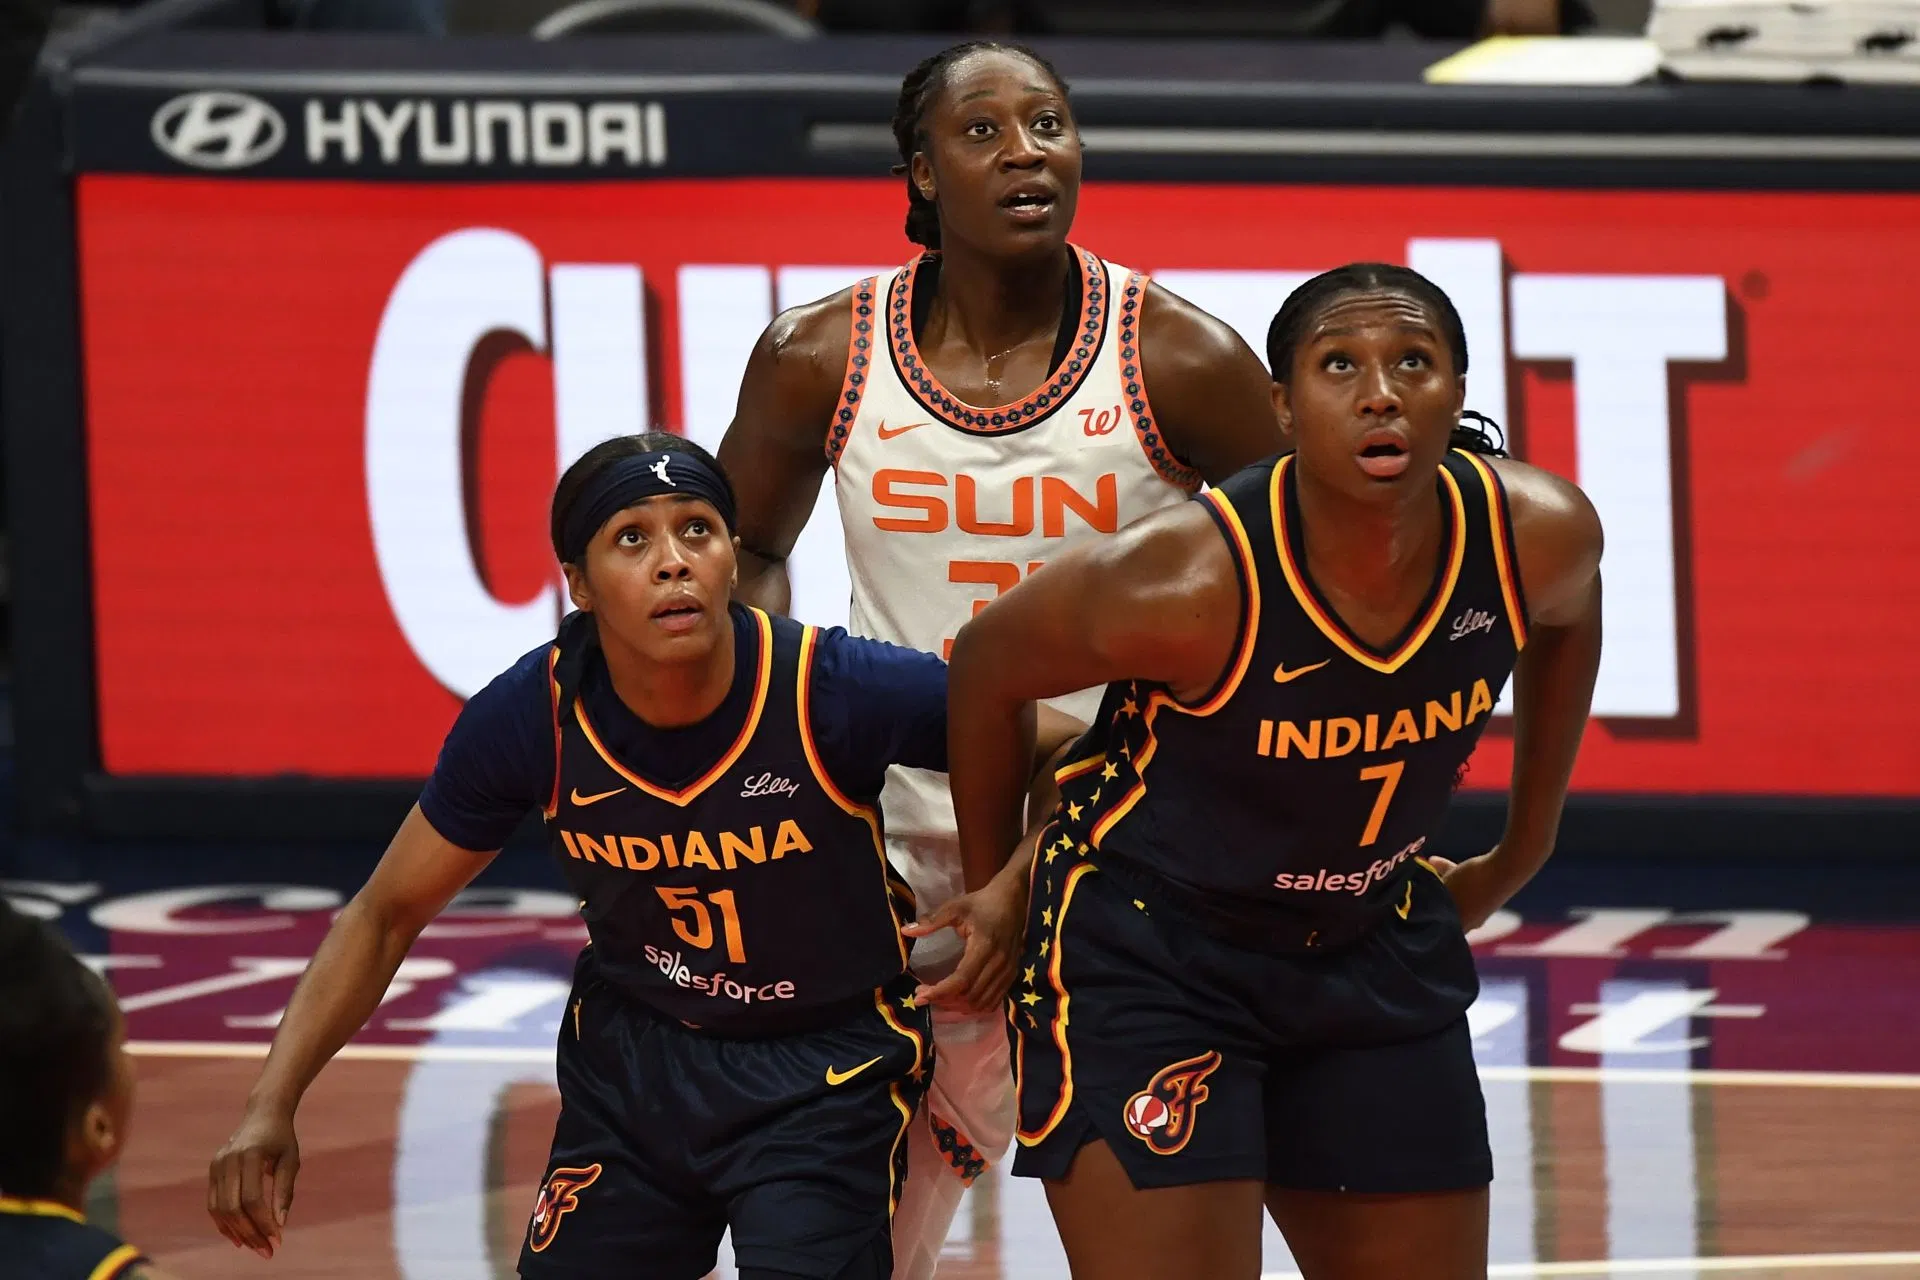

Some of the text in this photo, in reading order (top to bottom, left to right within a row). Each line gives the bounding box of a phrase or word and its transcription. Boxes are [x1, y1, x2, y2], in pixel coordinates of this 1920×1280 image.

[305, 100, 666, 165] HYUNDAI
[872, 468, 1118, 538] SUN
[1450, 608, 1496, 641] Lilly
[1257, 678, 1492, 759] INDIANA
[740, 772, 800, 798] Lilly
[1359, 760, 1405, 847] 7
[560, 819, 814, 871] INDIANA
[1274, 836, 1426, 896] salesforce
[655, 886, 746, 963] 51
[644, 944, 795, 1004] salesforce
